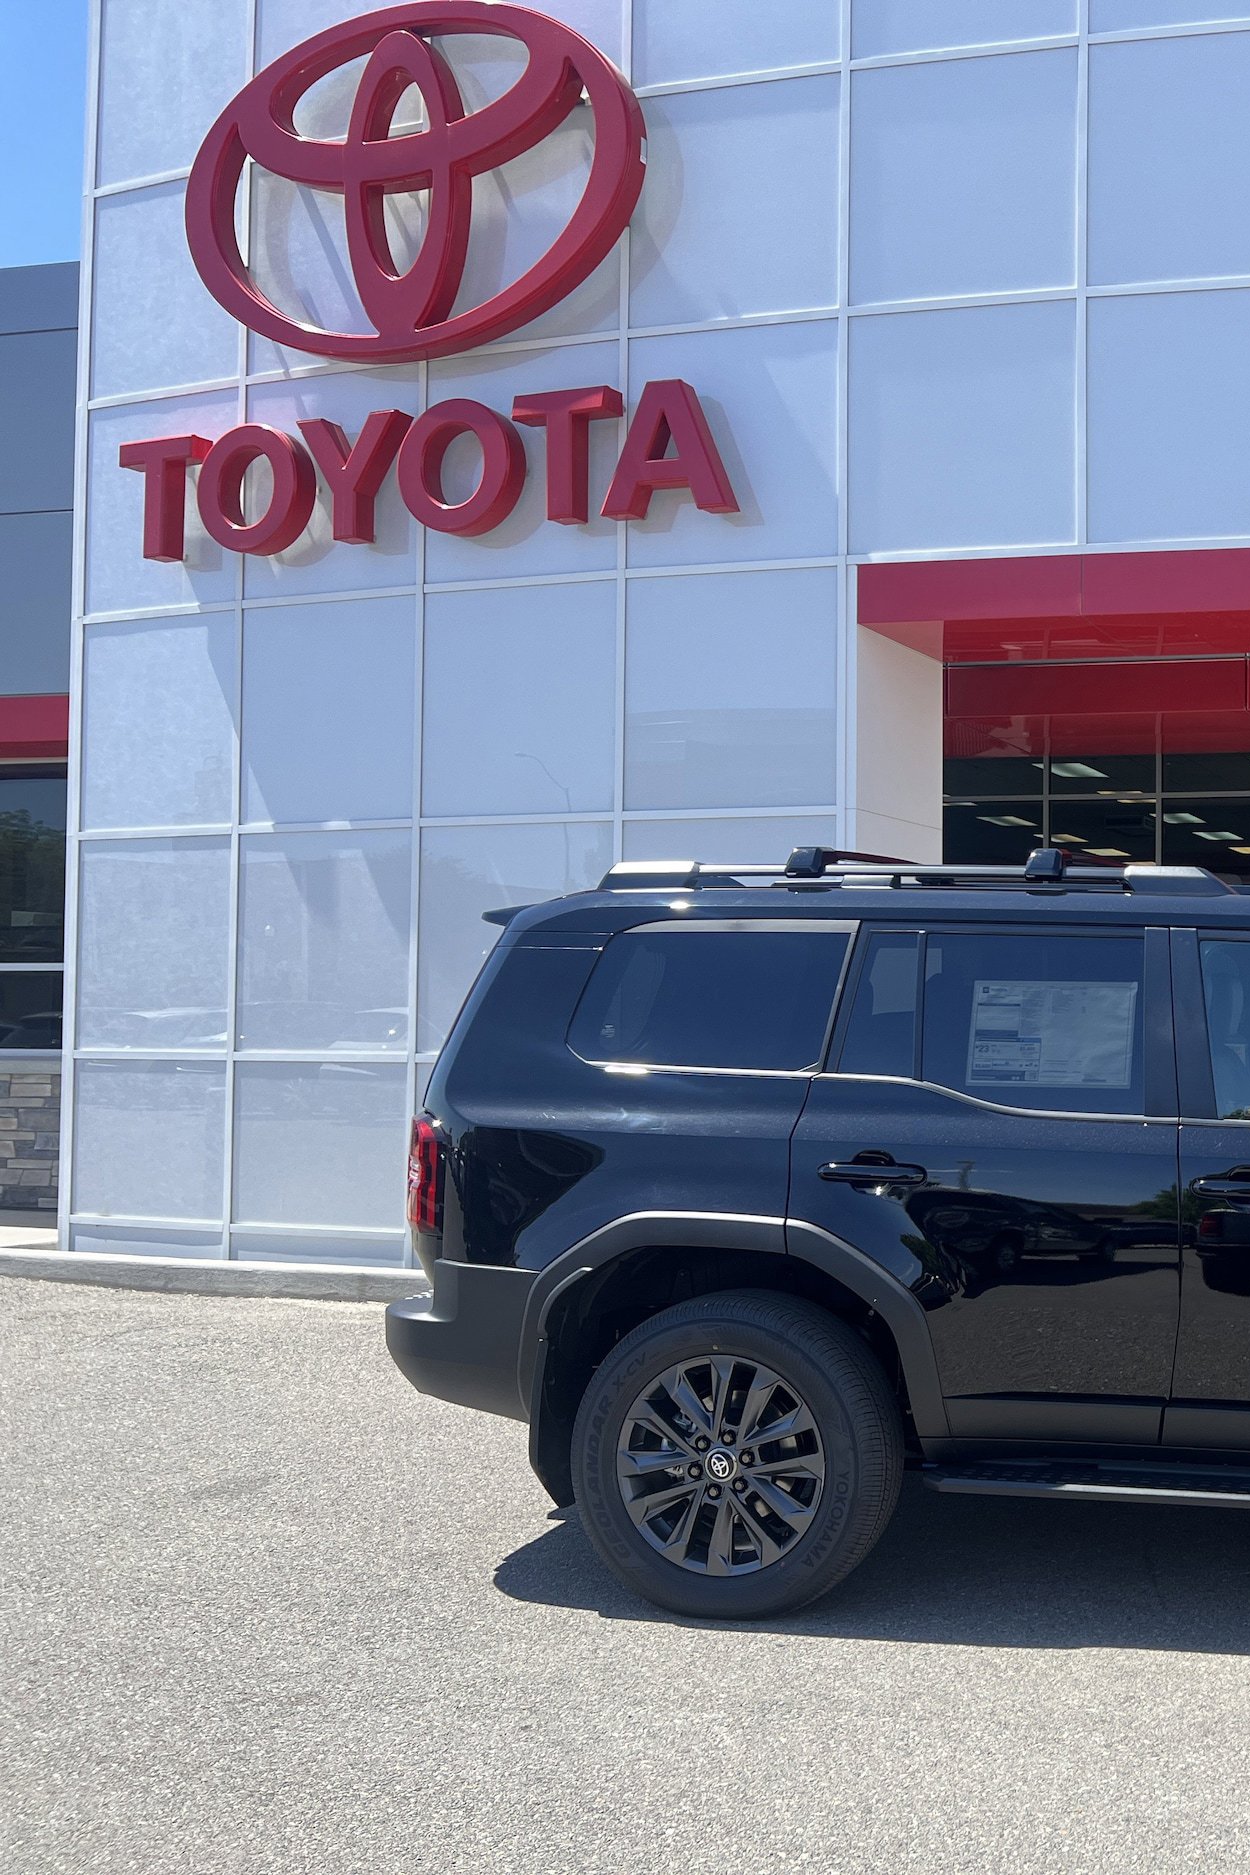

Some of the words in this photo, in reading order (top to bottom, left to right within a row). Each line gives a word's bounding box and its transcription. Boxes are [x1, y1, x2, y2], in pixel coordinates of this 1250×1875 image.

[119, 379, 740, 562] TOYOTA
[586, 1398, 628, 1557] GEOLANDAR
[802, 1471, 849, 1568] YOKOHAMA
